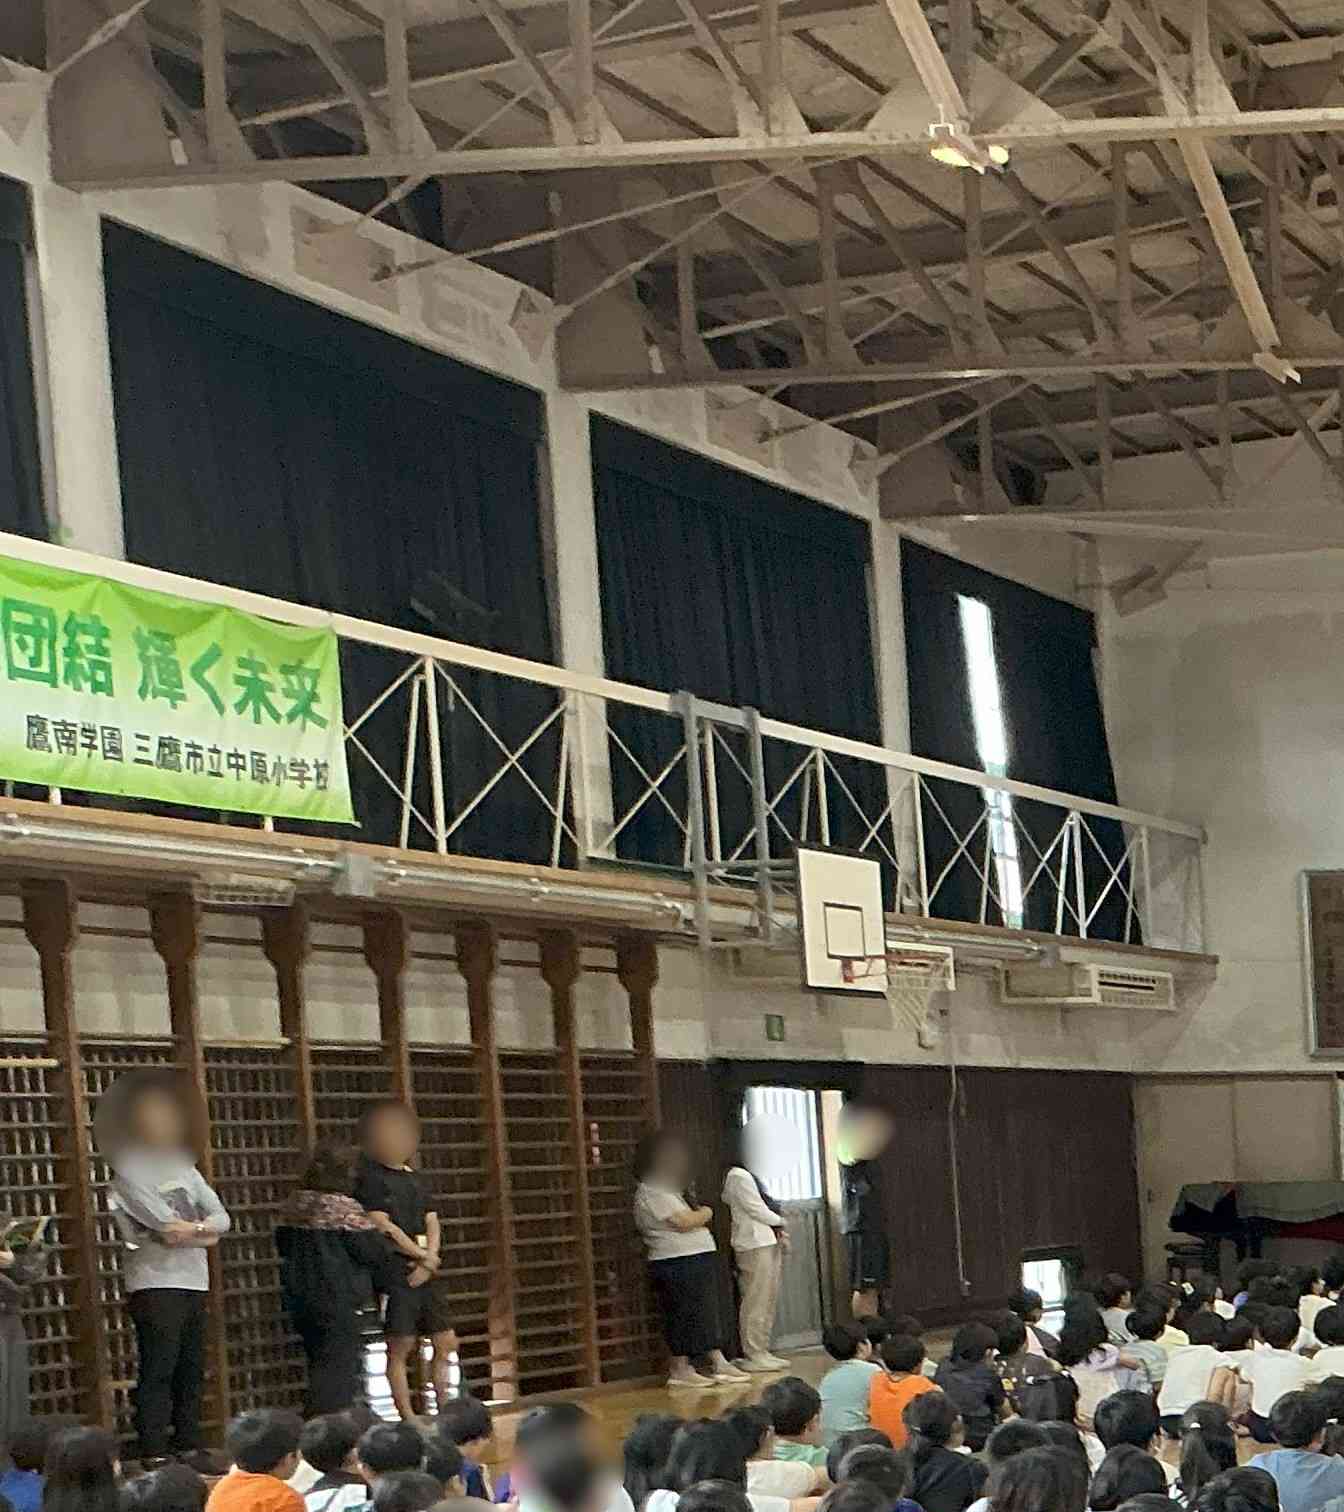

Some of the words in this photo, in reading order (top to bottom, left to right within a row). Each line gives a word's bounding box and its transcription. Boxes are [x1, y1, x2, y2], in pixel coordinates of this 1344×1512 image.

[1, 599, 114, 697] 団結
[132, 626, 328, 731] 輝く未来
[26, 714, 123, 762] 鷹南学園
[133, 733, 330, 790] 三鷹市立中原小学校
